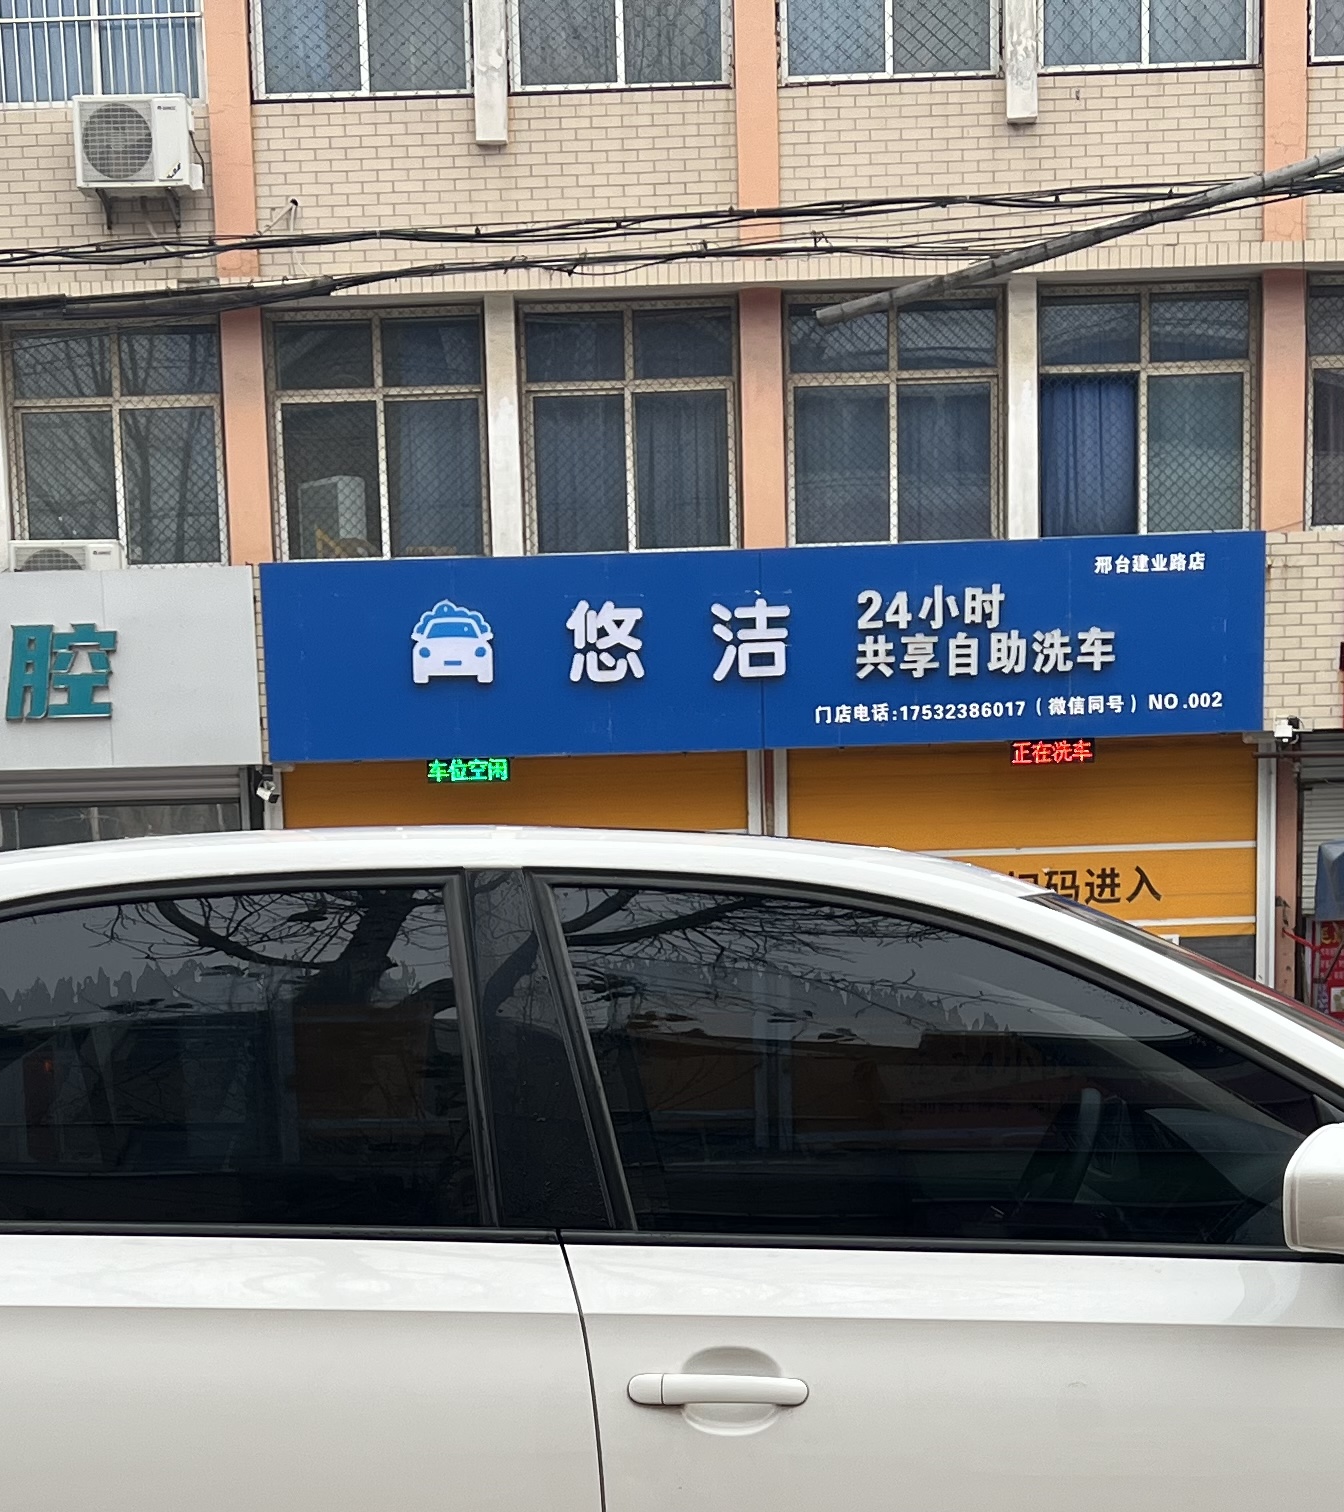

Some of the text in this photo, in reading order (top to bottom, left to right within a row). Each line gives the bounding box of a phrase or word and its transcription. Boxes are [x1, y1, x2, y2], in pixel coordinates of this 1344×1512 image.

[1094, 552, 1207, 575] 邢台建业路店
[857, 584, 1006, 630] 24小时
[566, 598, 791, 682] 悠洁
[856, 626, 1116, 678] 共享自助洗车
[1011, 740, 1093, 764] 正在洗车
[427, 758, 509, 783] 车位空闲
